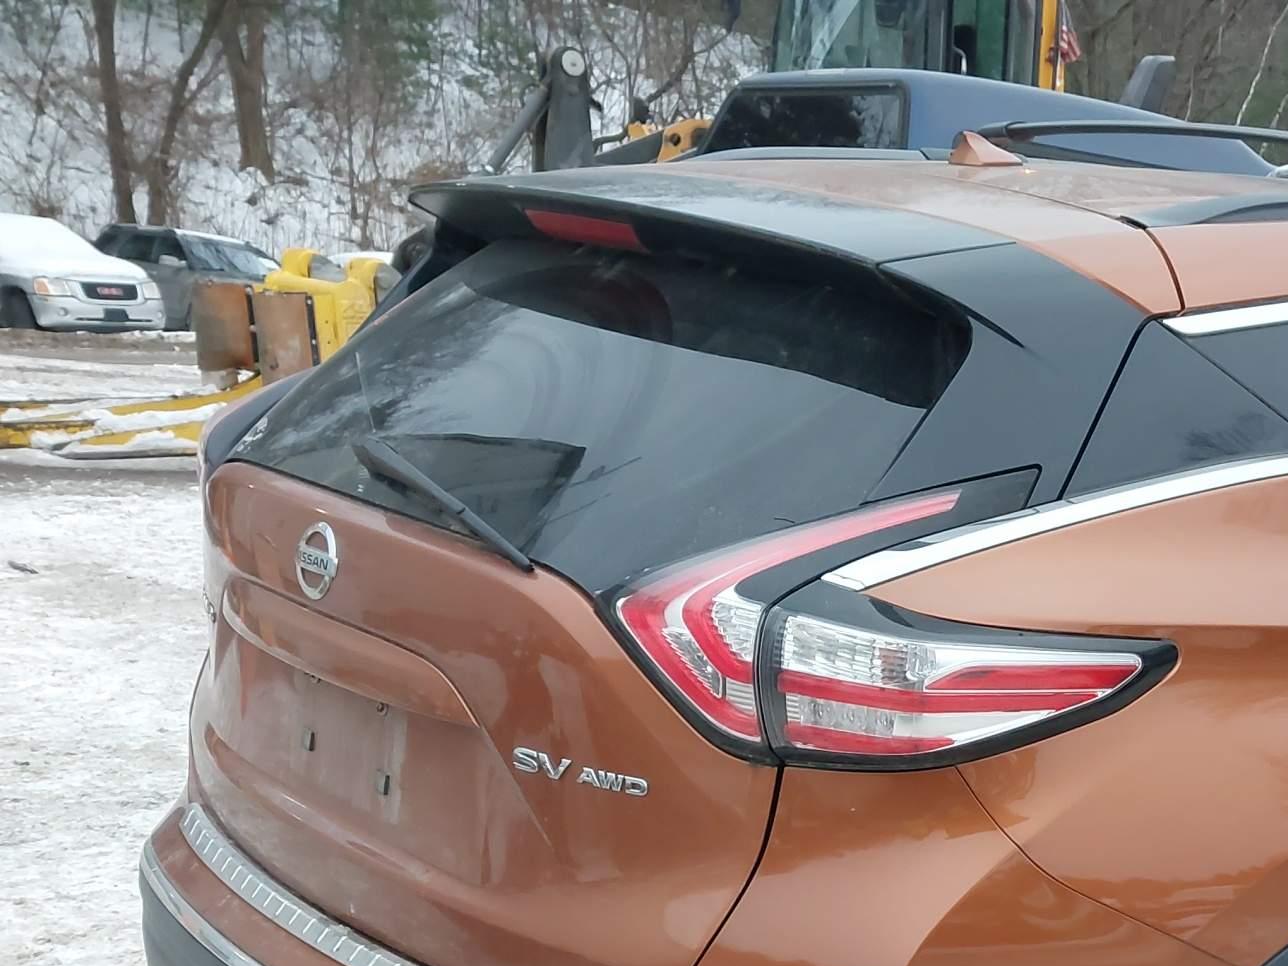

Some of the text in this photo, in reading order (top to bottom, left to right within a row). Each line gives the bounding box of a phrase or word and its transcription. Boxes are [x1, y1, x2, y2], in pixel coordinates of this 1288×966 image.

[298, 550, 329, 570] ISSAN
[512, 746, 649, 797] SV AWD
